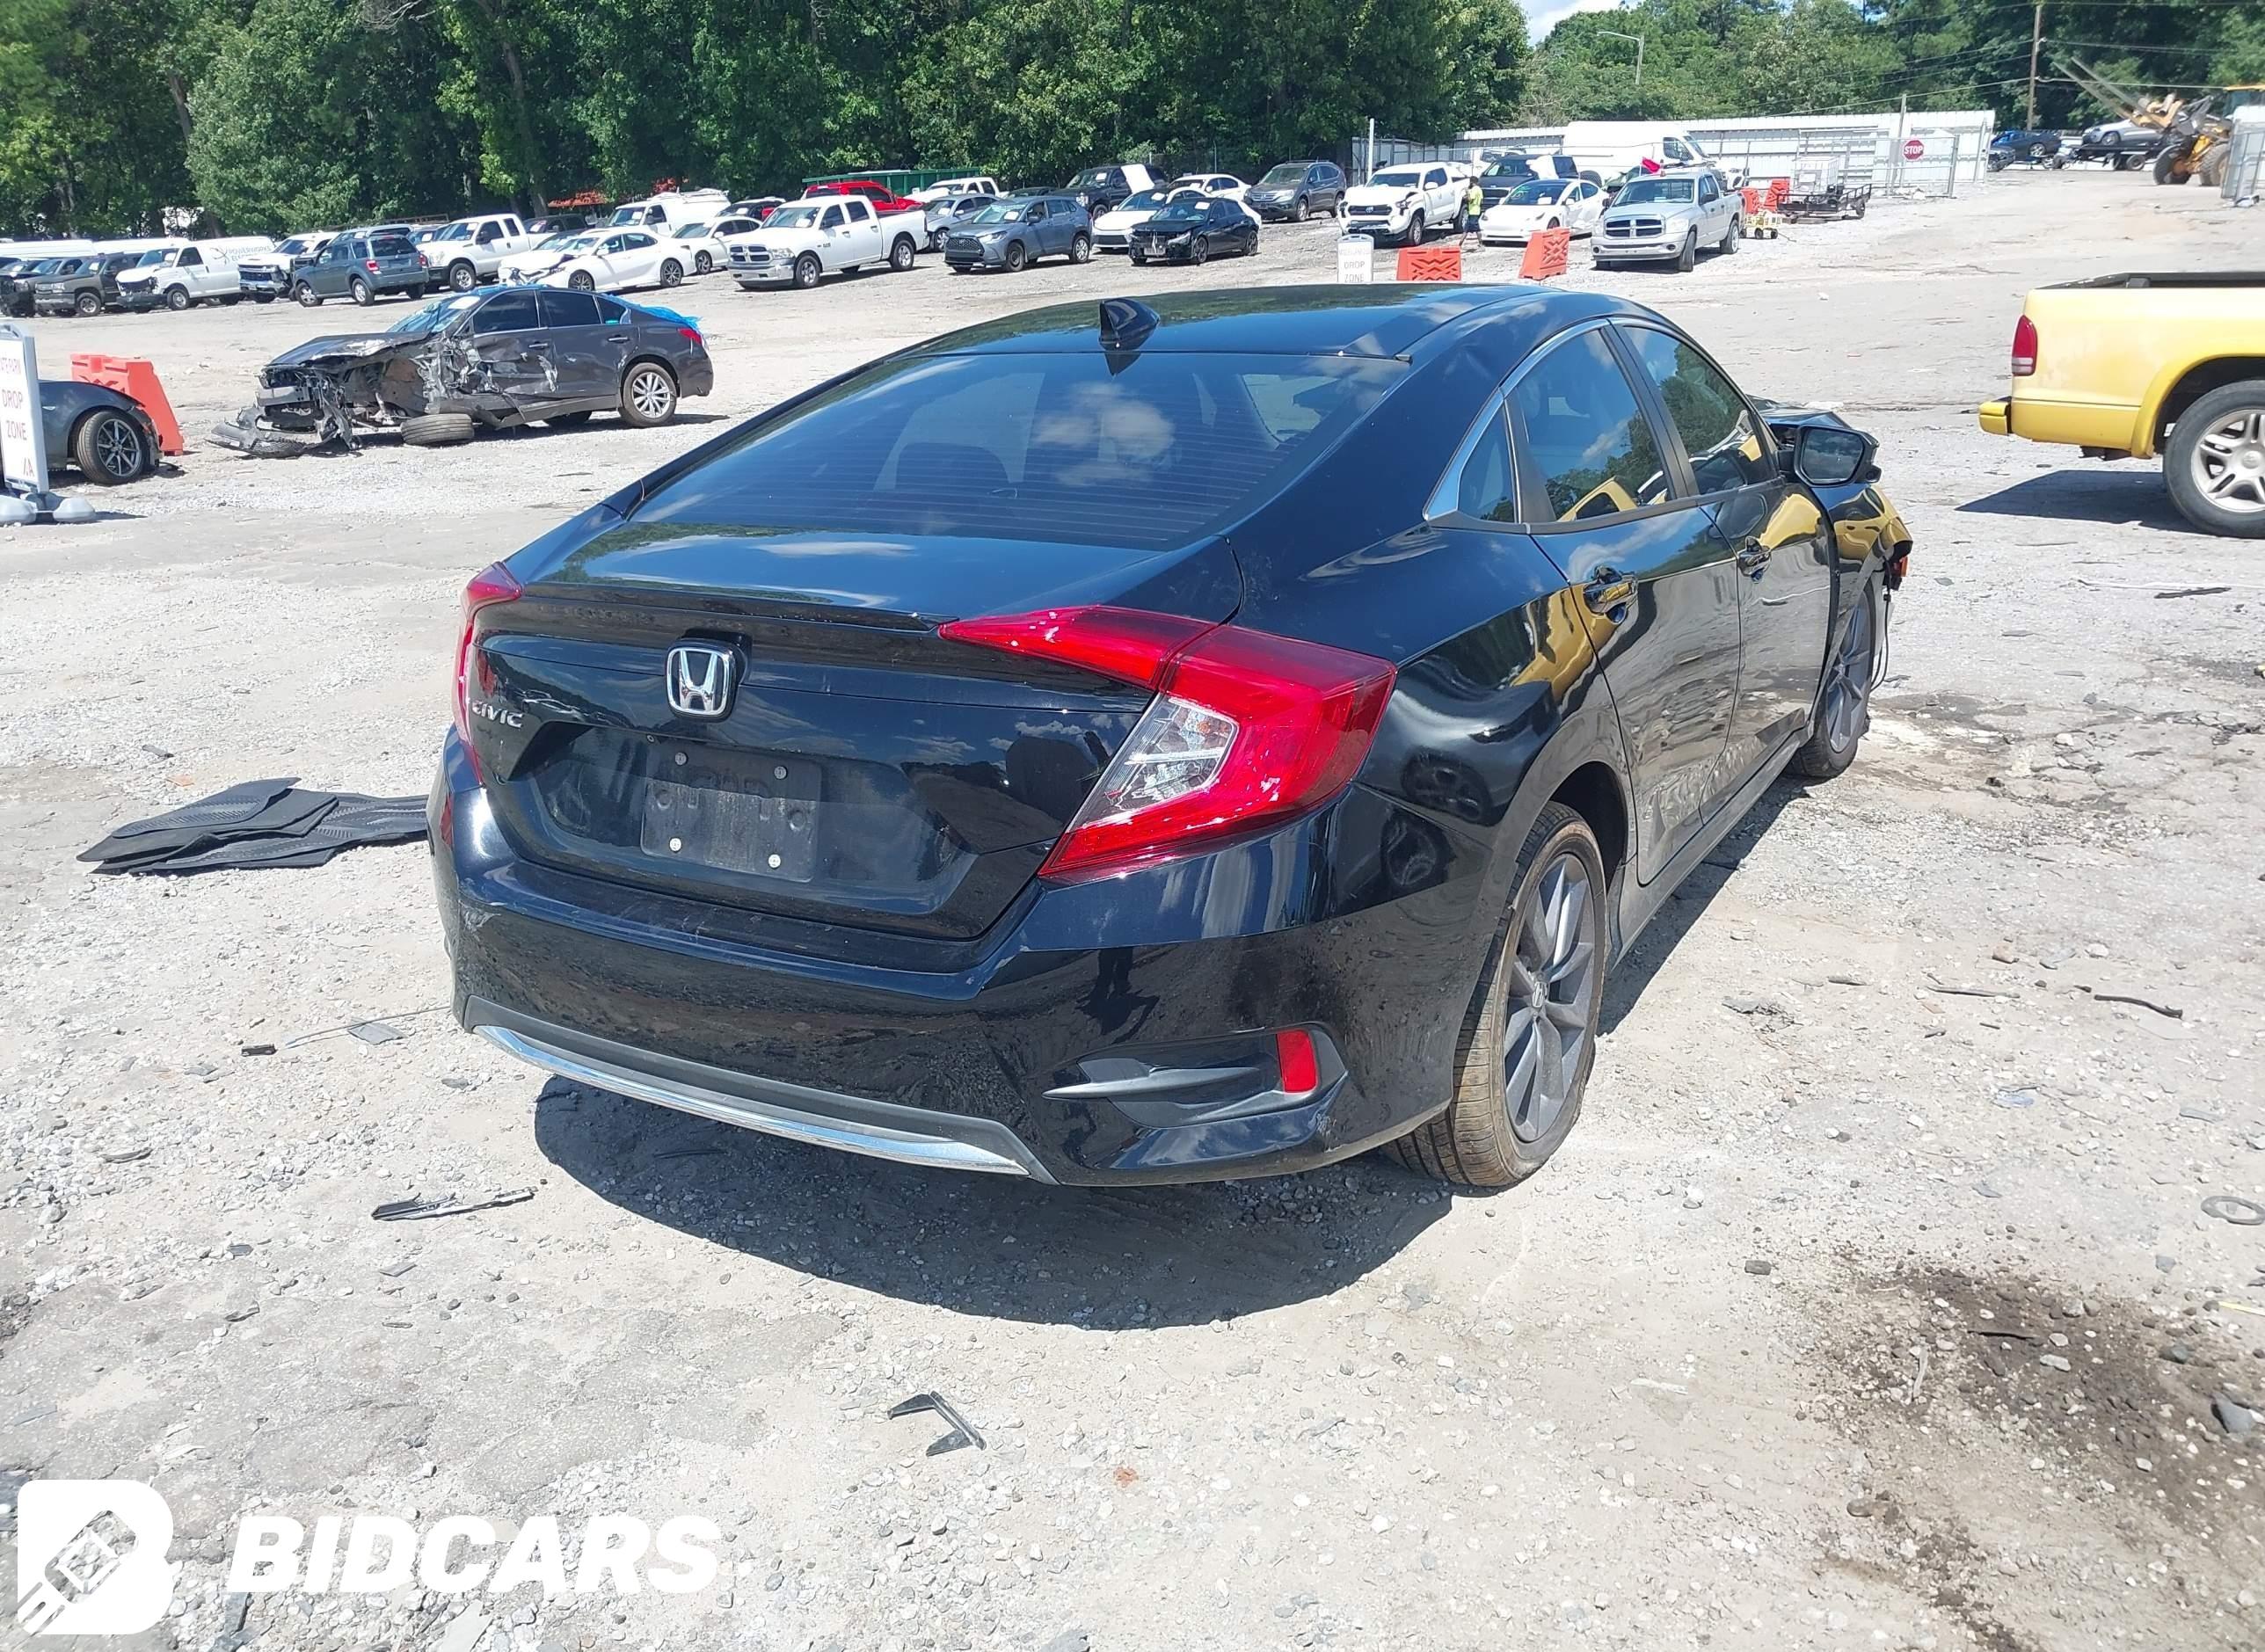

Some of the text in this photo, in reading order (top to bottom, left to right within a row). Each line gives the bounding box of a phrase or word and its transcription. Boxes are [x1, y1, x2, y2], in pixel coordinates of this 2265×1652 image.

[1904, 145, 1924, 156] STOP
[1344, 260, 1366, 269] DROP
[1344, 273, 1365, 282] ZONE
[2, 389, 24, 410] DROP
[6, 420, 27, 440] ZONE
[471, 701, 524, 729] CIVIC
